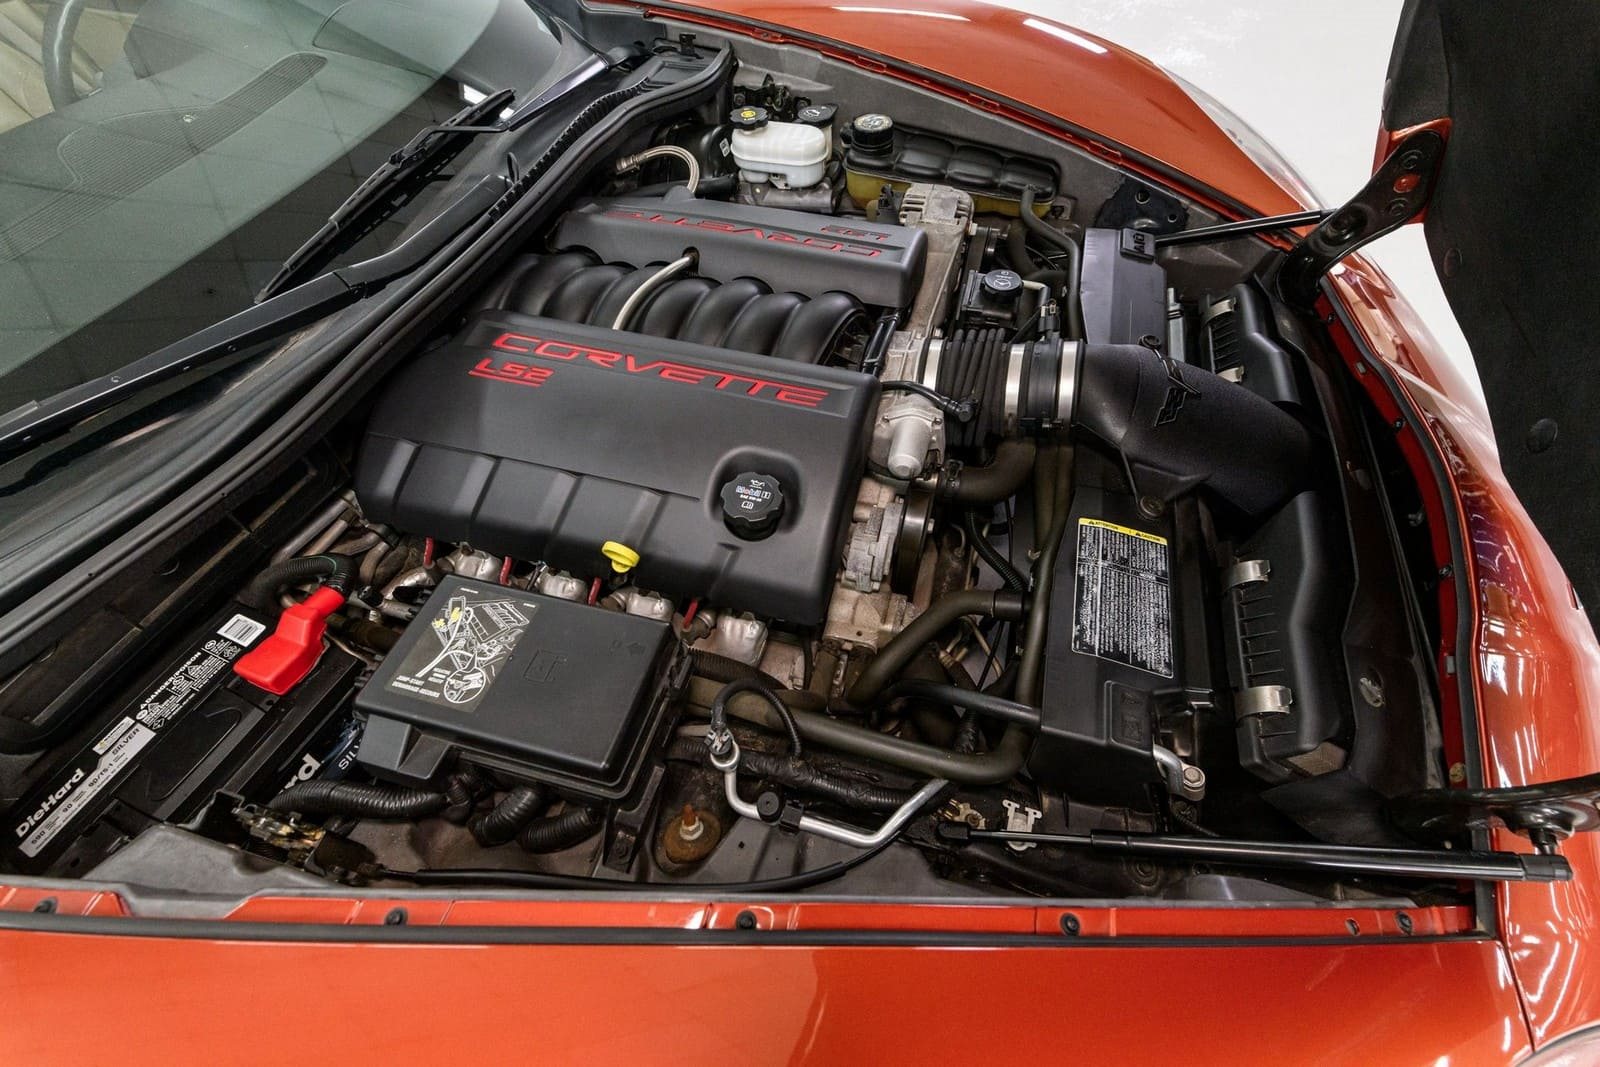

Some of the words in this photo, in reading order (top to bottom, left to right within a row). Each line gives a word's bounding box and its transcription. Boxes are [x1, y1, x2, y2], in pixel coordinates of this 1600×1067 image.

[605, 210, 882, 257] CORVETTE
[820, 225, 891, 241] LS2
[468, 357, 555, 387] LS2
[491, 332, 829, 407] CORVETTE
[736, 486, 761, 497] Mobil
[1095, 521, 1118, 531] ATTENTION
[111, 727, 141, 756] SILVER
[15, 767, 85, 838] DieHard
